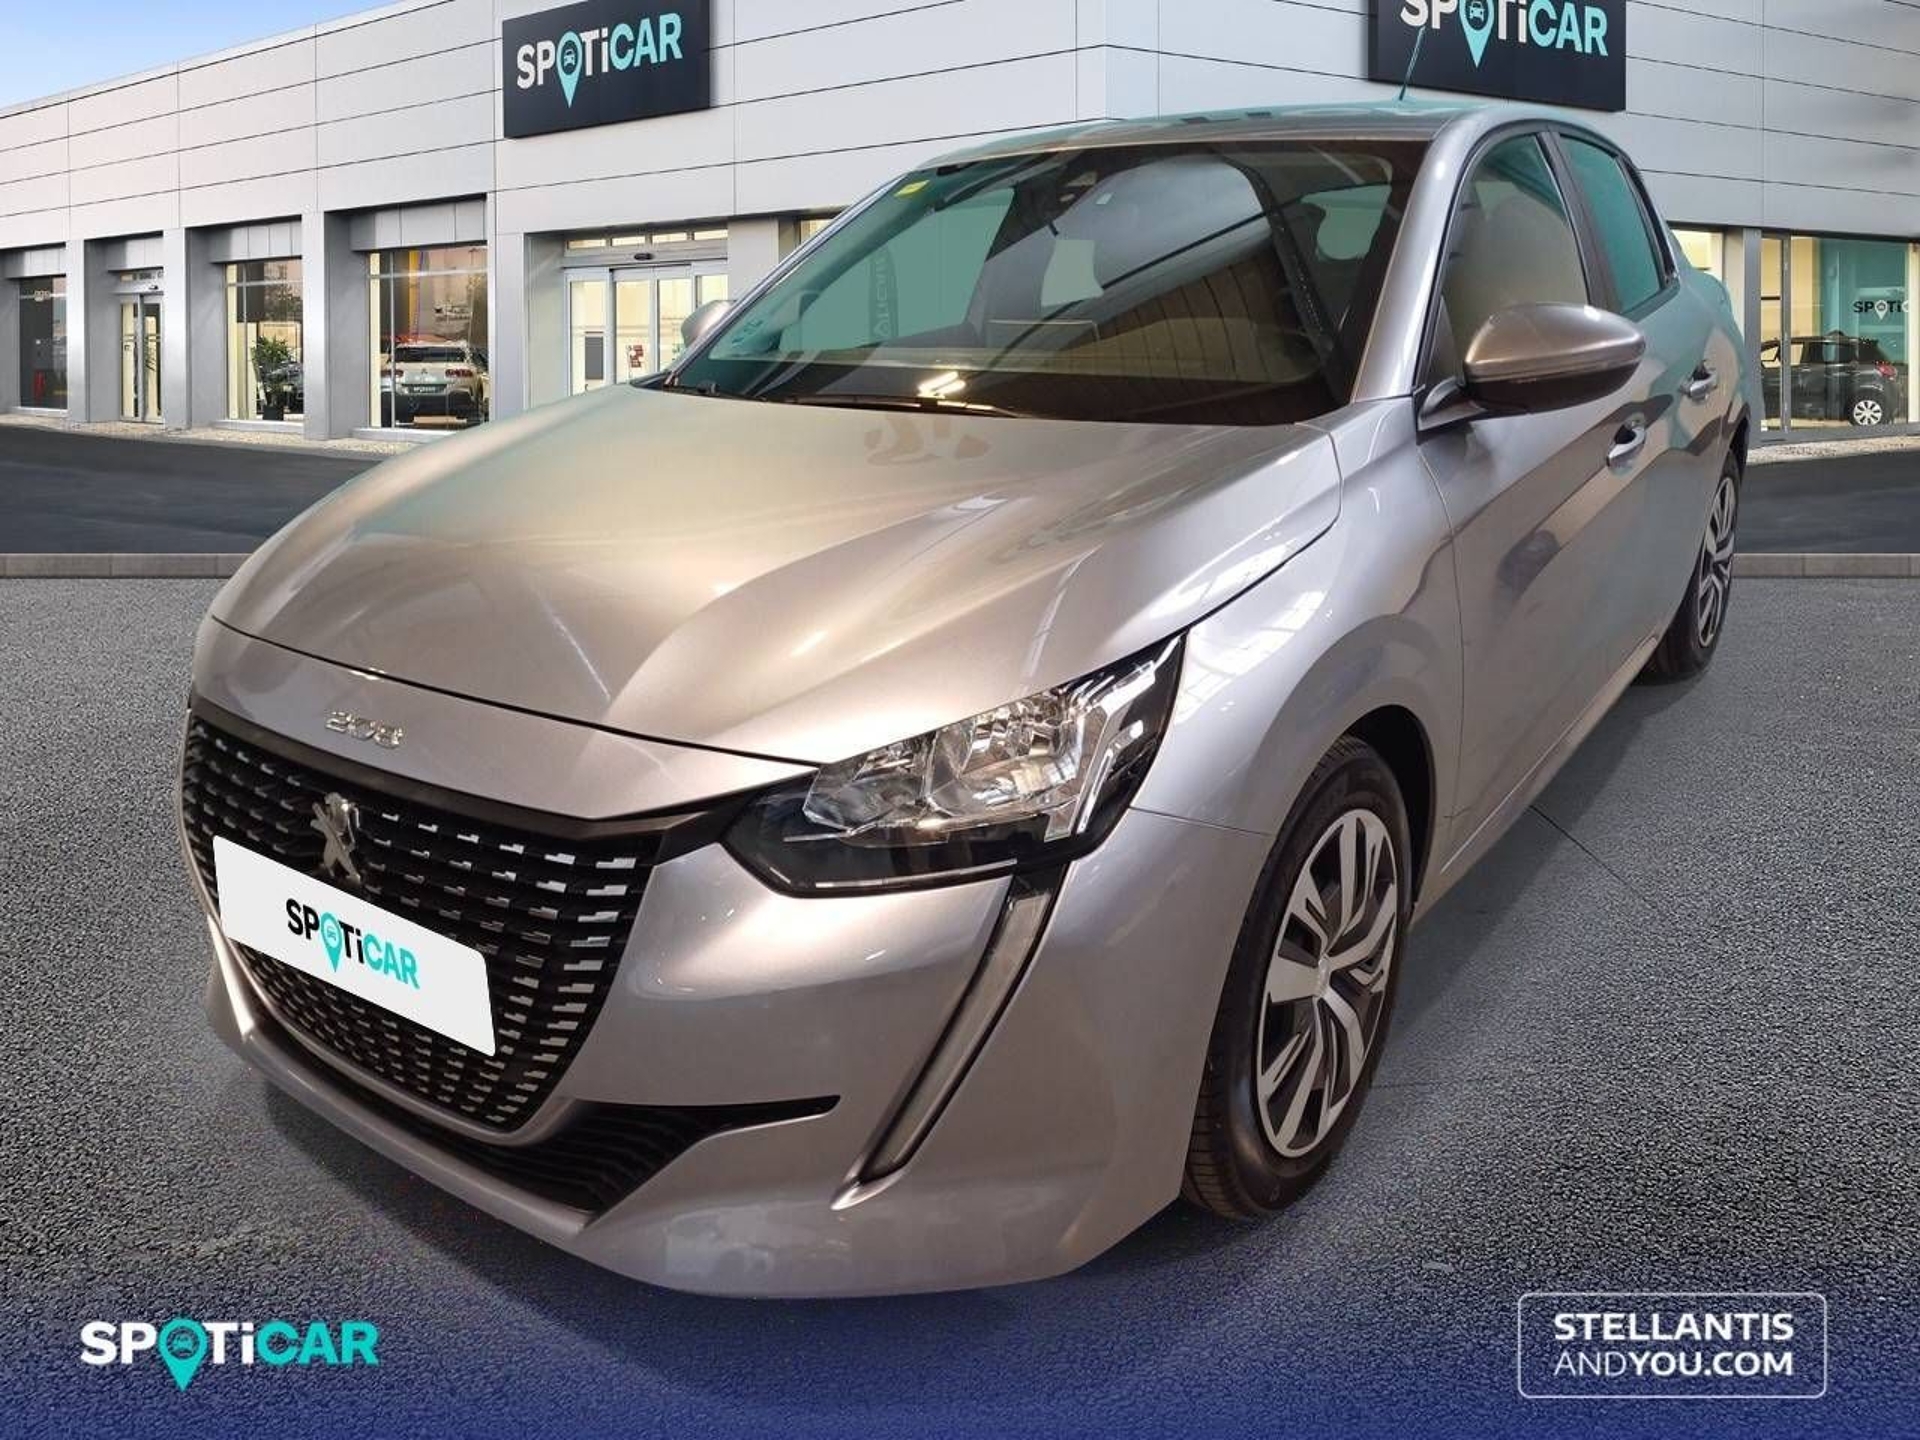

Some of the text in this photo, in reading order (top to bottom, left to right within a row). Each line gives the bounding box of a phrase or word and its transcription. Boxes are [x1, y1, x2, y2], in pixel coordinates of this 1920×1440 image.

[516, 13, 683, 108] SPOTiCAR
[1400, 0, 1608, 68] SPOTiCAR
[285, 898, 421, 989] SPOTiCAR
